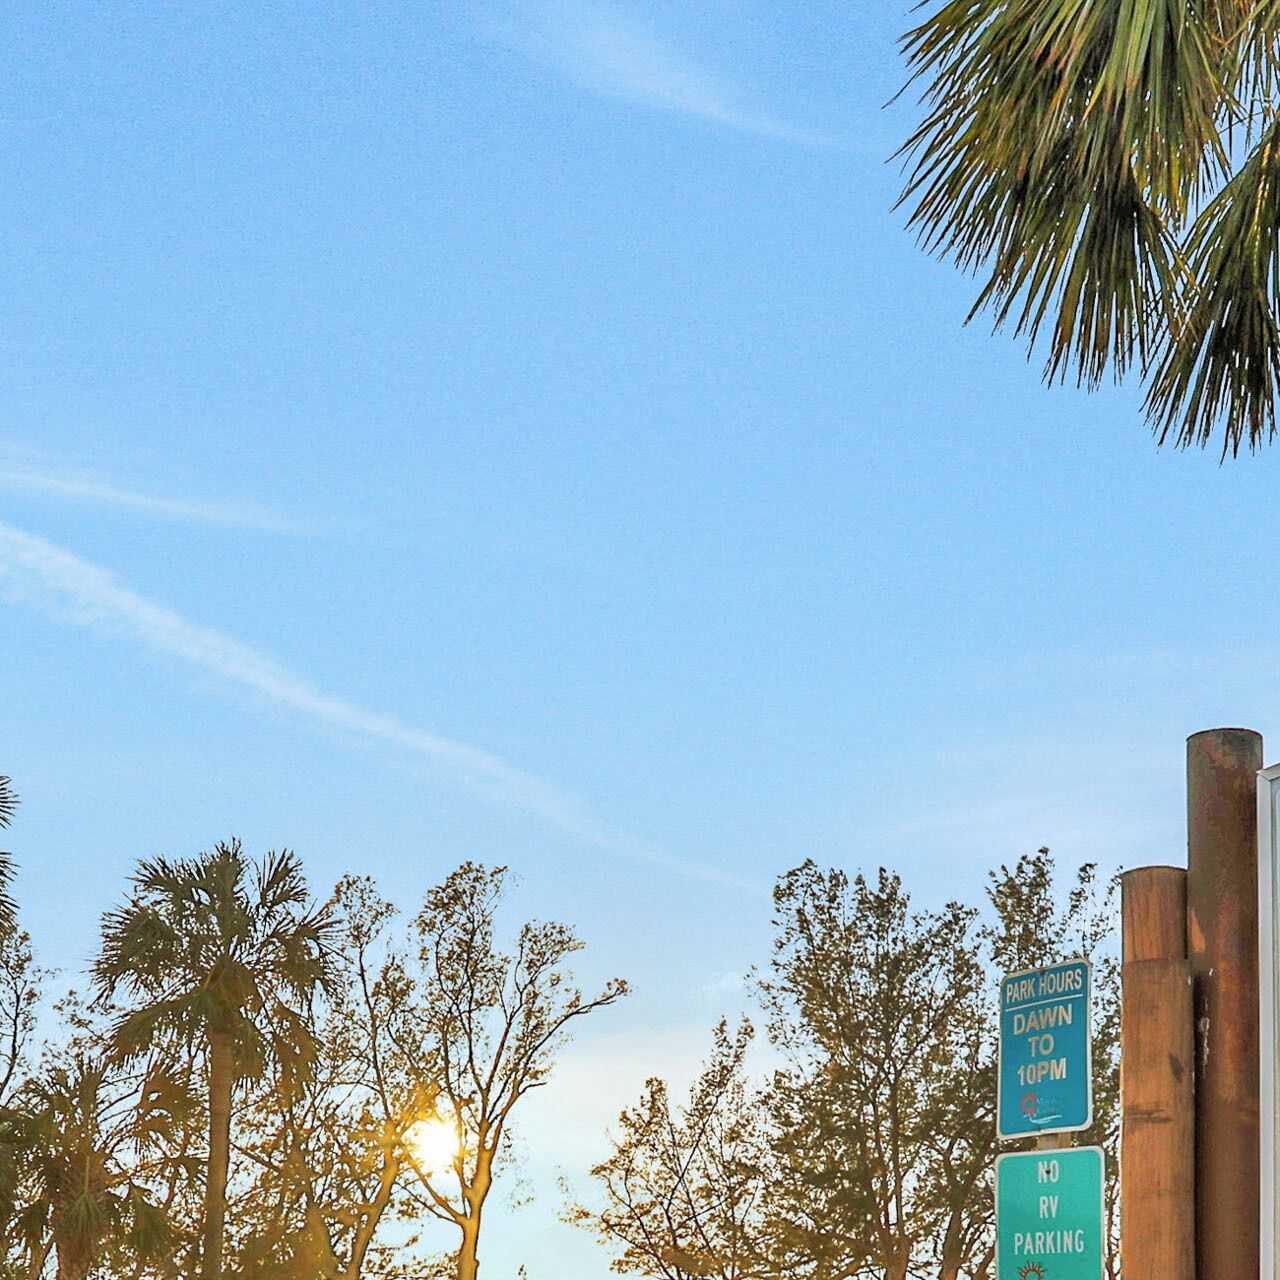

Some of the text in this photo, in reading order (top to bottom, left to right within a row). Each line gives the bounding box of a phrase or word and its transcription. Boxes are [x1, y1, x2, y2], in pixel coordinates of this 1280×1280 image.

[1006, 968, 1082, 1004] PARK HOURS
[1013, 1003, 1073, 1035] DAWN
[1027, 1032, 1055, 1057] TO
[1017, 1057, 1067, 1086] 10PM
[1038, 1160, 1060, 1184] NO
[1039, 1195, 1059, 1219] RV
[1014, 1229, 1085, 1256] PARKING
